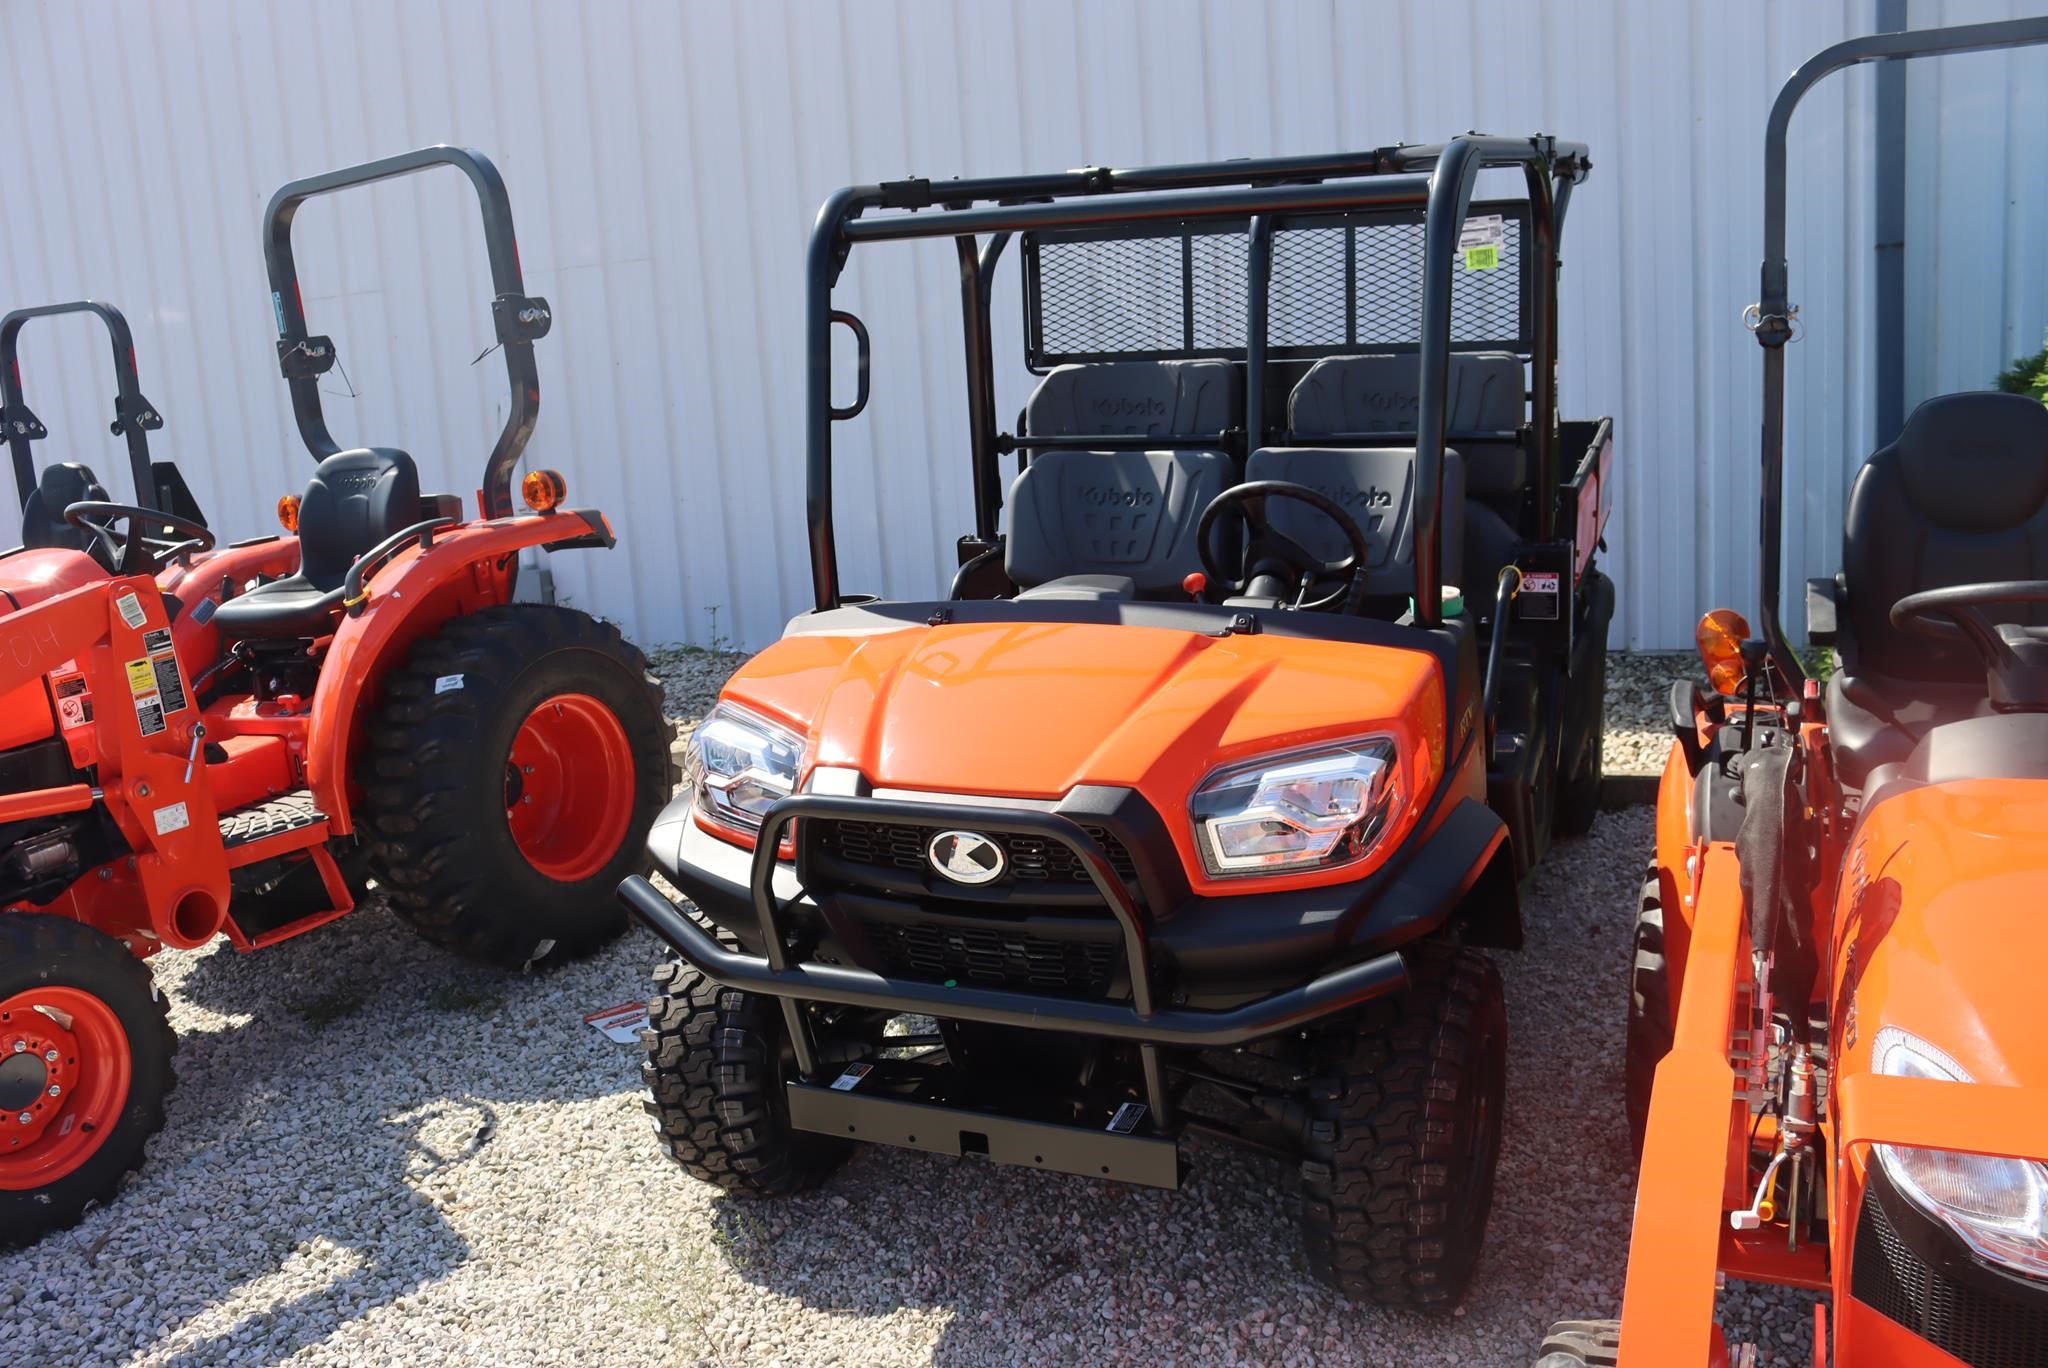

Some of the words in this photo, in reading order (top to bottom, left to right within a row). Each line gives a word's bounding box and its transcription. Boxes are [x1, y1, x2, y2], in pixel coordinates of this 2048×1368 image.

[1091, 396, 1165, 417] Kubota
[1362, 391, 1418, 413] Kubo
[1078, 486, 1154, 508] Kubota
